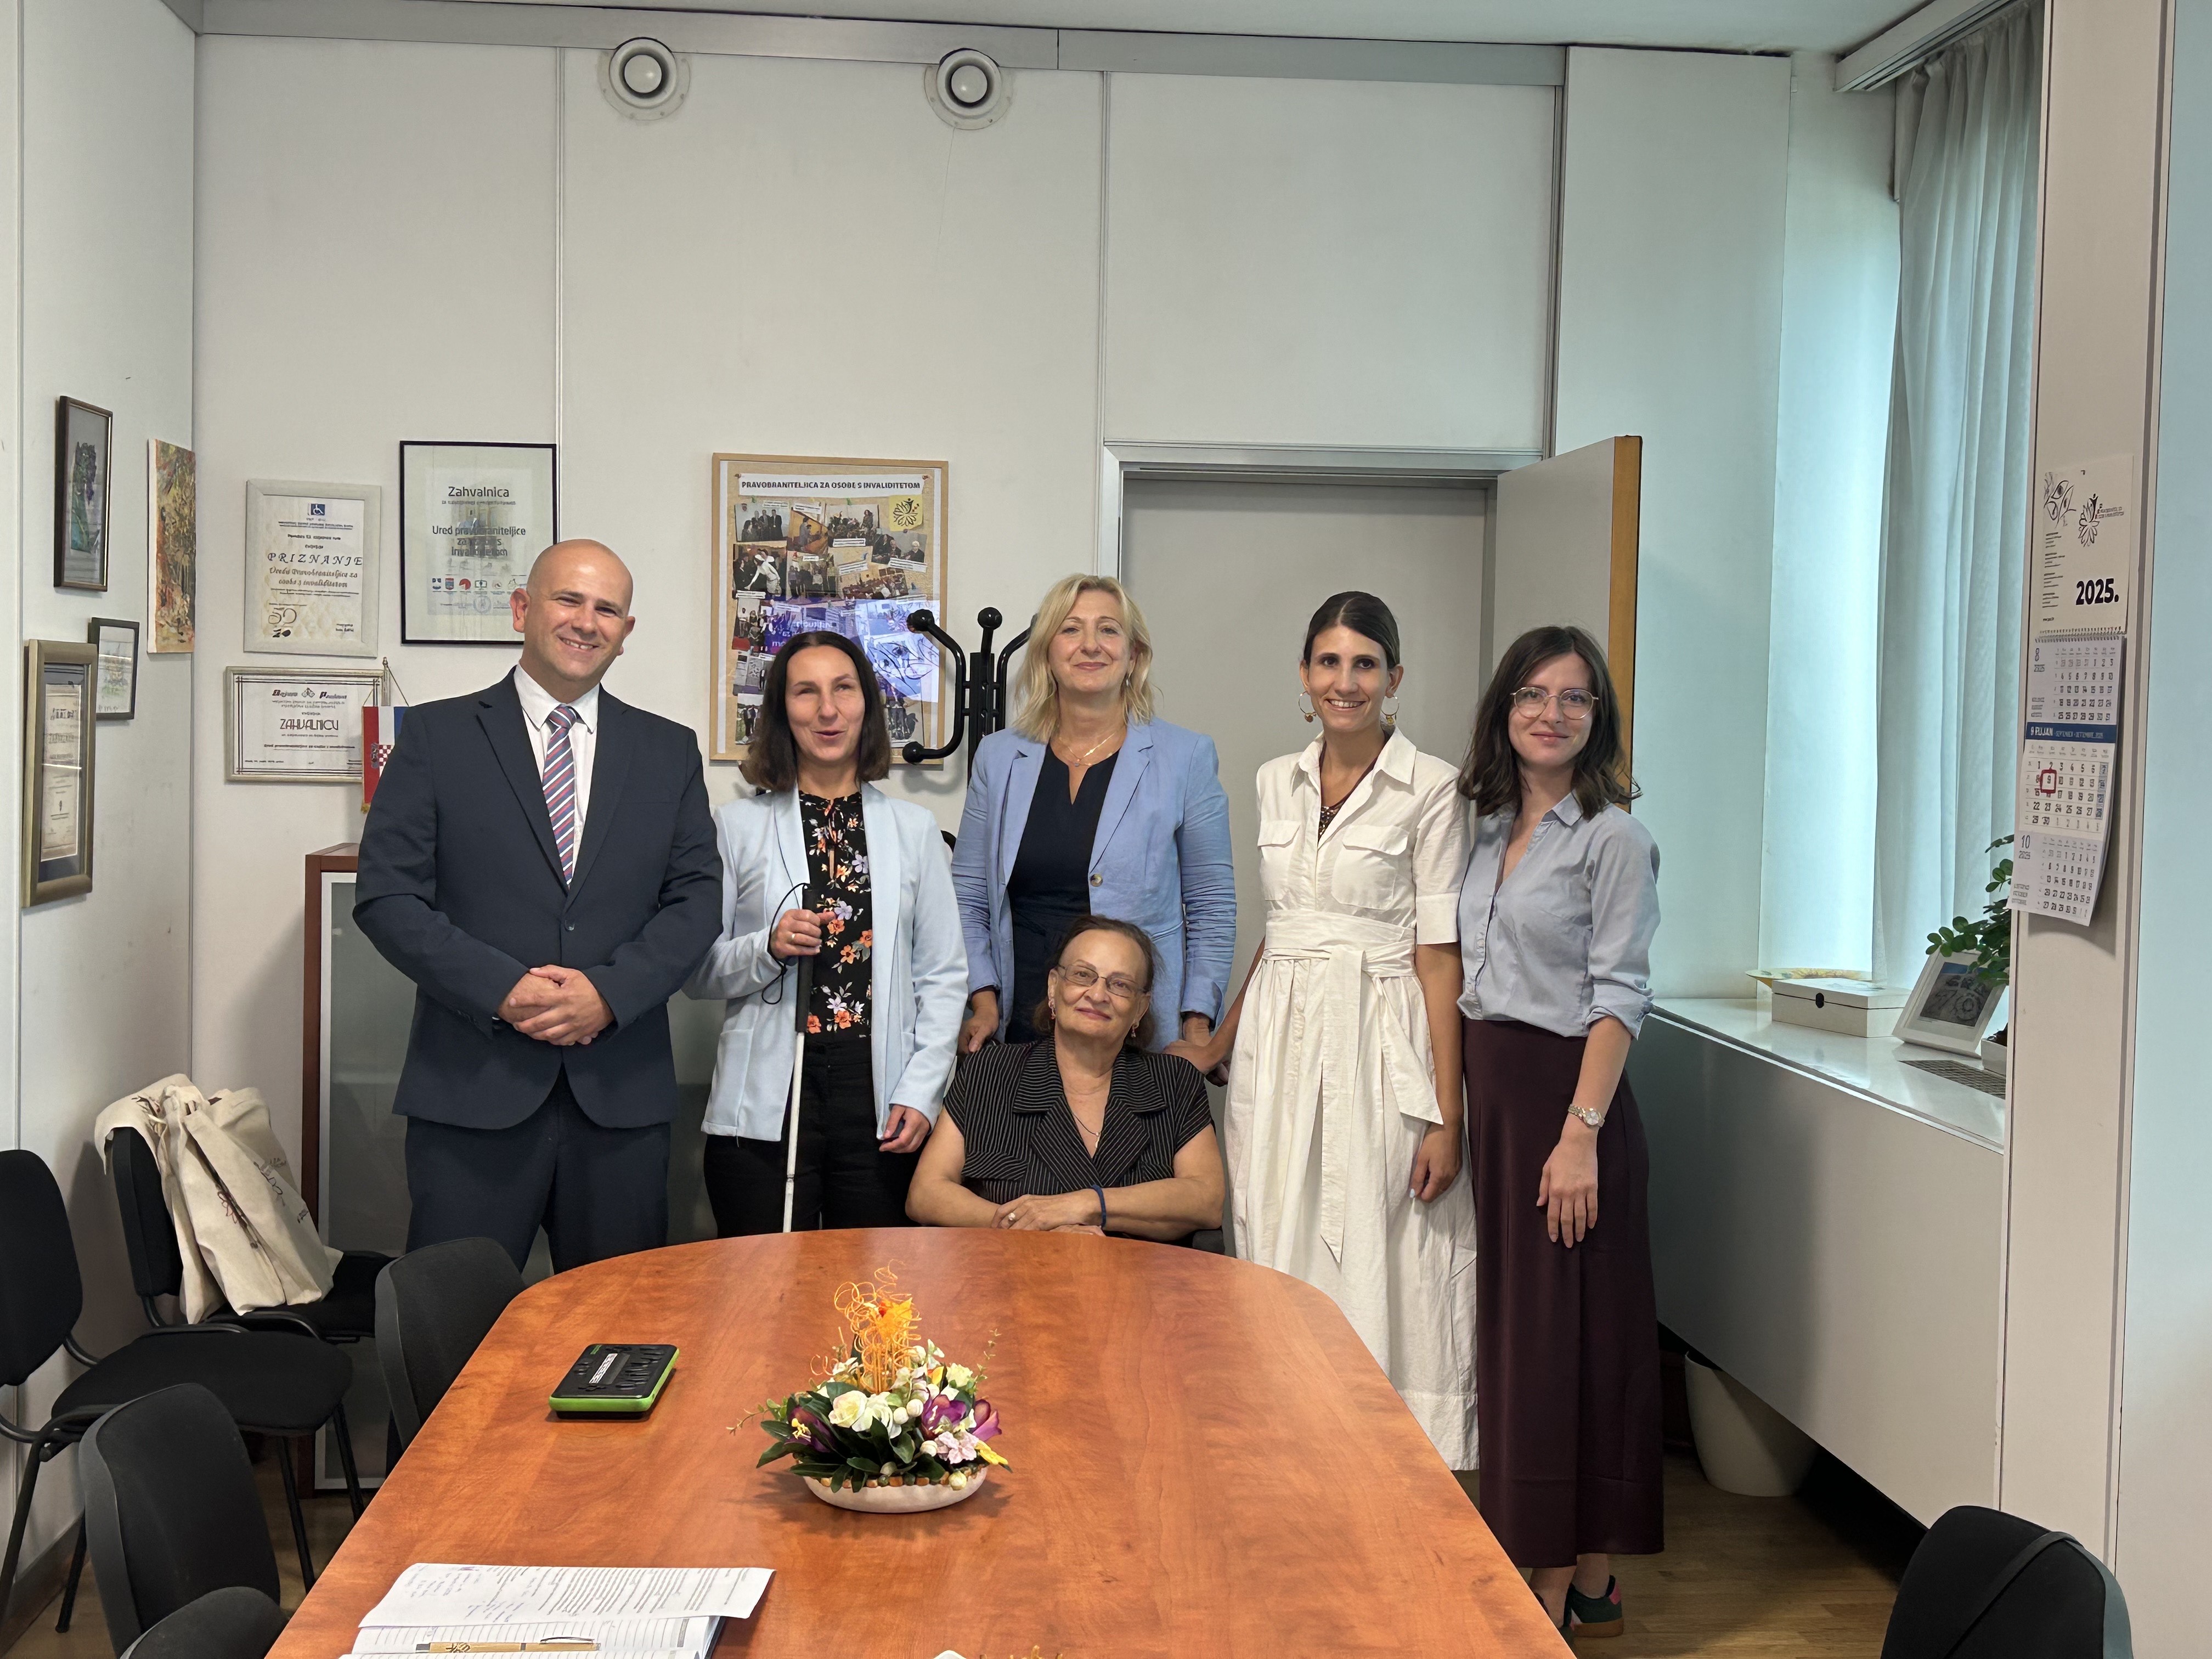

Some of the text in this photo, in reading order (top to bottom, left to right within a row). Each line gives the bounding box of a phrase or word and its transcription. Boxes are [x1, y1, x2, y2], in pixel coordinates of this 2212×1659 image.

[448, 486, 510, 498] Zahvalnica
[432, 525, 453, 534] Ured
[268, 553, 363, 566] PRIZNANJE
[2075, 578, 2119, 605] 2025.
[280, 719, 338, 730] ZAHVALNICU
[2060, 763, 2063, 771] 3
[2047, 775, 2051, 783] 9
[2022, 835, 2030, 849] 10
